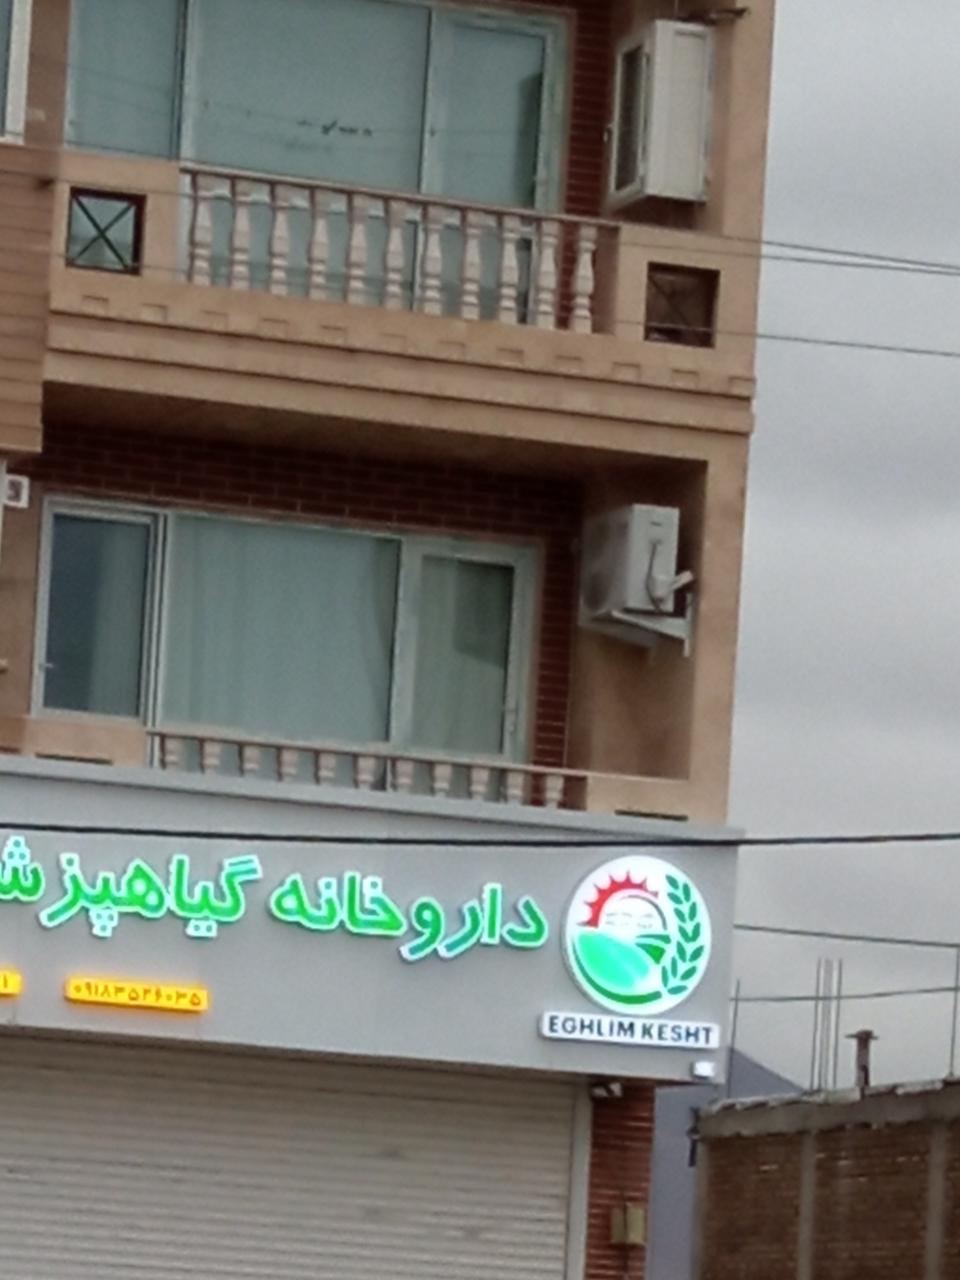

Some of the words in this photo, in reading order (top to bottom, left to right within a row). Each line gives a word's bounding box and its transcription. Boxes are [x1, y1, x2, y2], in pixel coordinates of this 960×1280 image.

[269, 870, 549, 963] داروخانه
[548, 1015, 636, 1040] EGHLIM
[640, 1022, 714, 1046] KESHT
